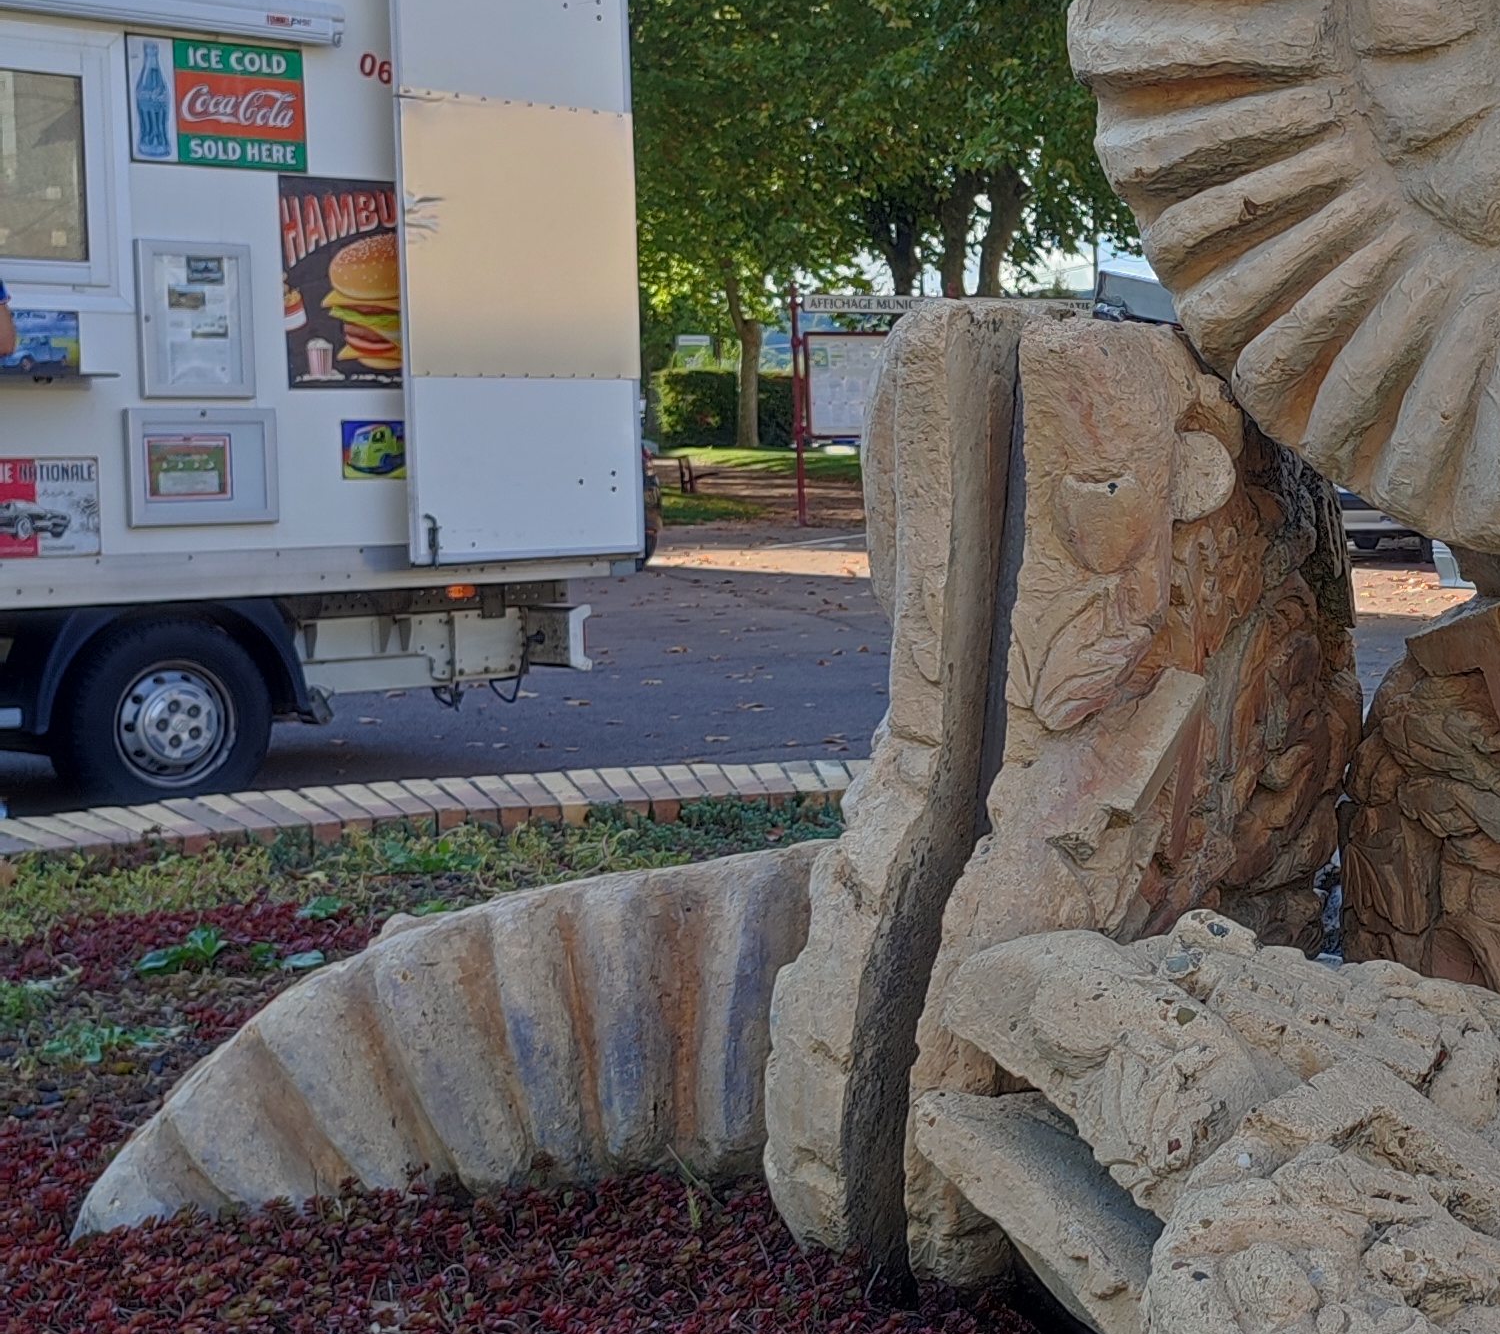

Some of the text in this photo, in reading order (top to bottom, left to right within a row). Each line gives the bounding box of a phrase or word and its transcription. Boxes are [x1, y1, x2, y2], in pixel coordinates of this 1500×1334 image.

[188, 47, 287, 74] ICE COLD
[360, 53, 392, 85] 06
[189, 138, 296, 165] SOLD HERE
[810, 298, 873, 309] AFFICHAGE
[19, 463, 95, 482] NATIONALE
